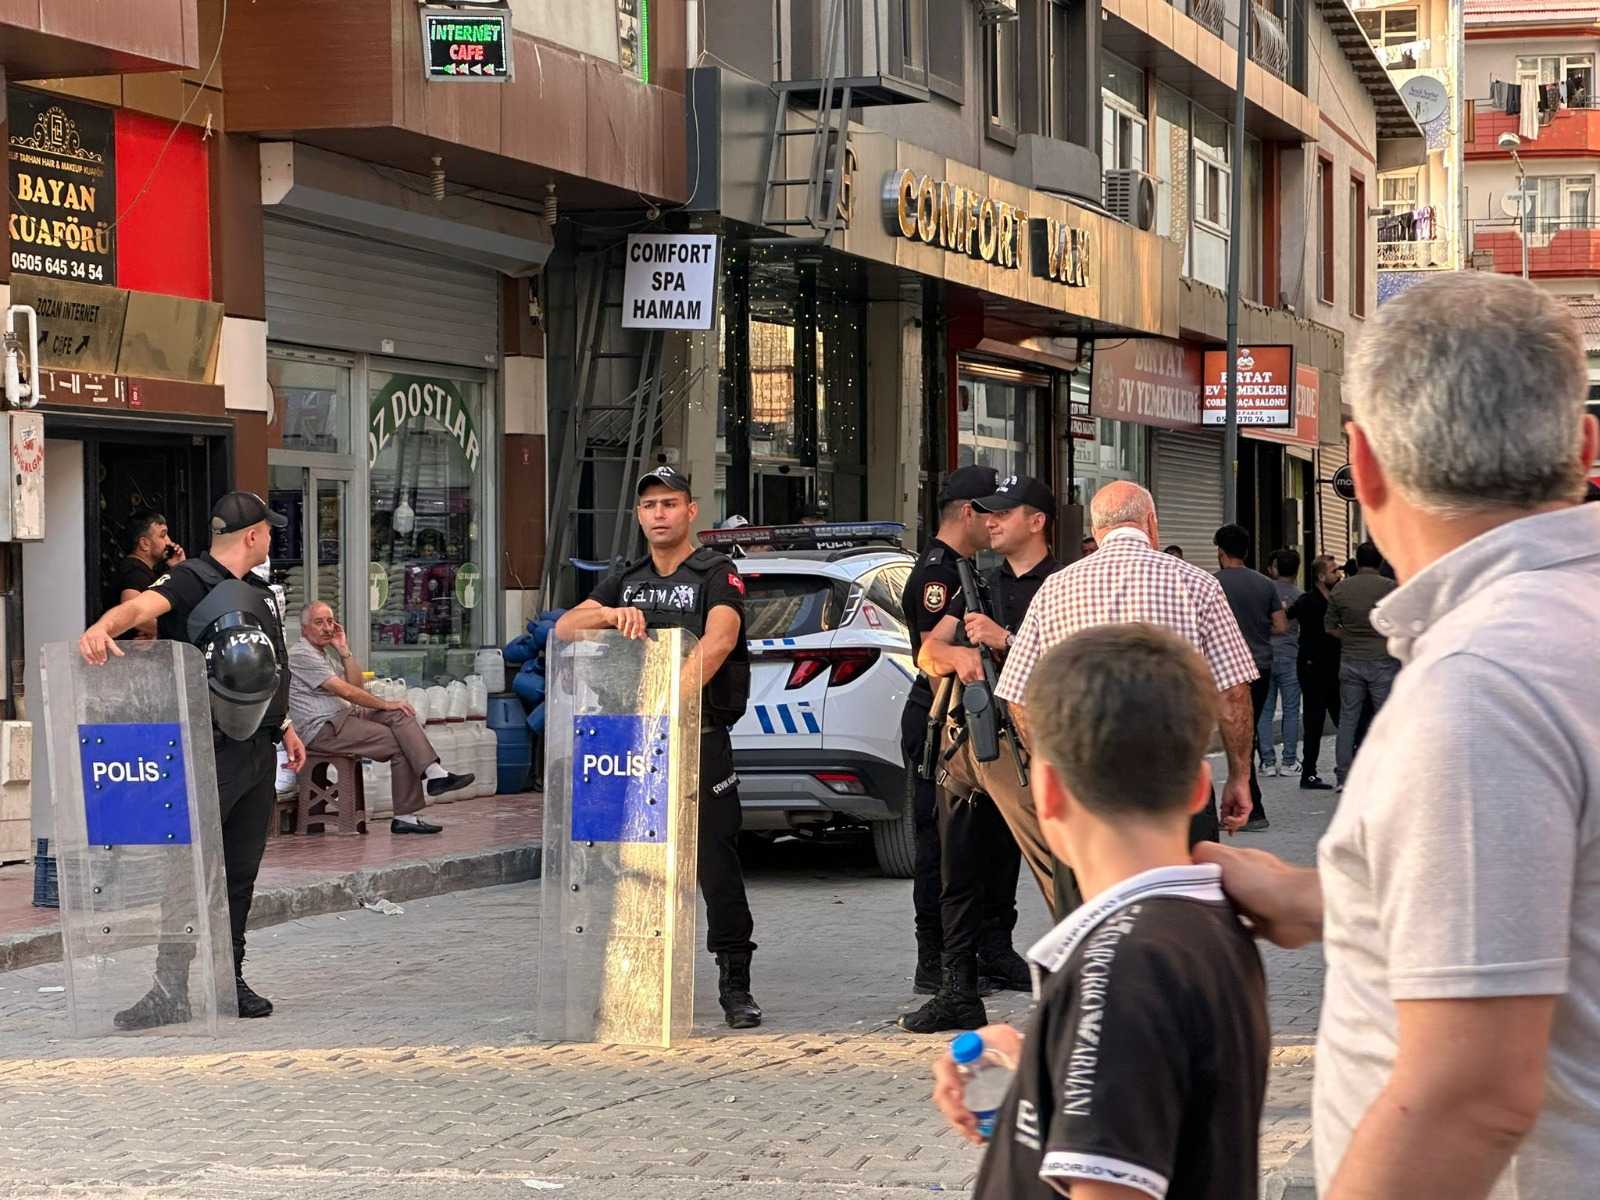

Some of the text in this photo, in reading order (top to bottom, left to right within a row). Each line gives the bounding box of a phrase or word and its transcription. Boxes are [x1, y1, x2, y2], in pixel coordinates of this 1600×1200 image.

[449, 44, 484, 61] CAFE
[17, 173, 96, 213] BAYAN
[885, 168, 1028, 270] COMFORT
[11, 252, 104, 281] 0505 645 34 54
[630, 243, 712, 264] COMFORT
[652, 271, 686, 292] SPA
[36, 297, 62, 318] ZOZAN
[632, 299, 702, 321] HAMAM
[1118, 378, 1135, 413] EV
[1205, 385, 1220, 395] EV
[1255, 398, 1287, 406] SALONU
[392, 383, 480, 473] DOSTLAR
[93, 757, 160, 783] POLİS
[583, 751, 645, 777] POLİS
[1063, 1042, 1098, 1116] ARMANI
